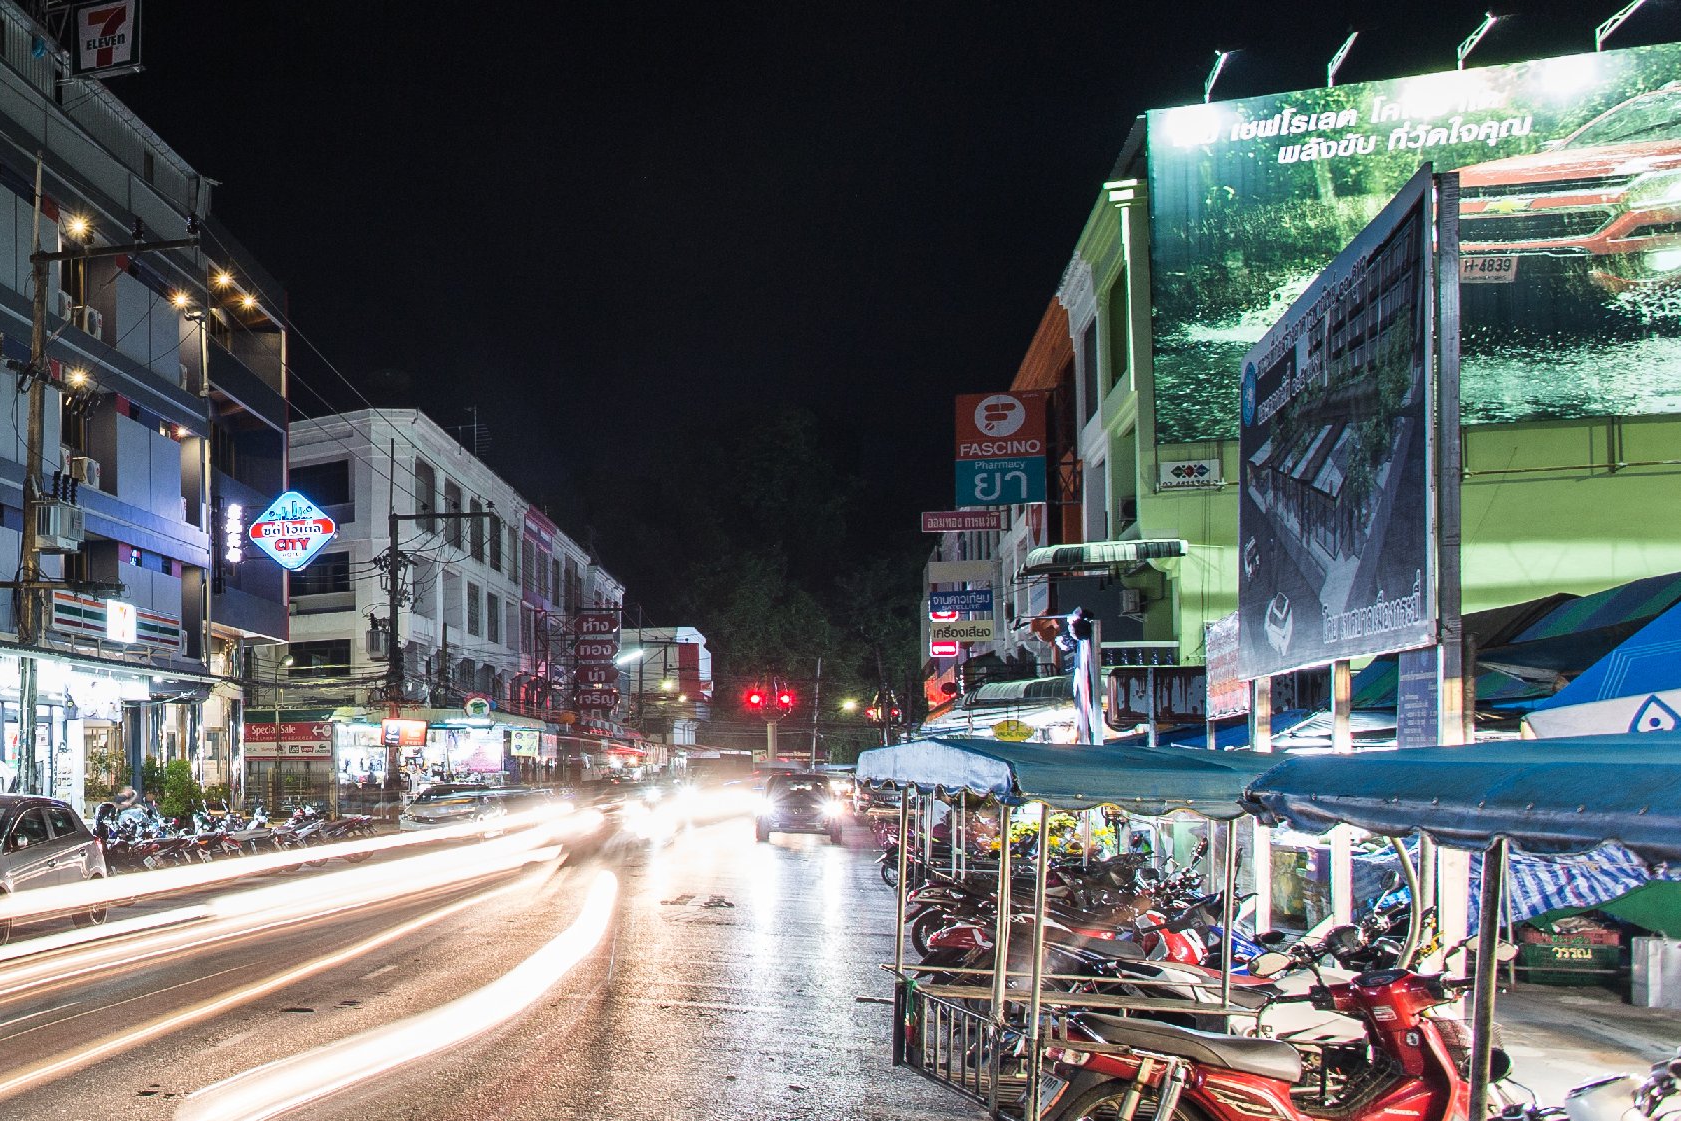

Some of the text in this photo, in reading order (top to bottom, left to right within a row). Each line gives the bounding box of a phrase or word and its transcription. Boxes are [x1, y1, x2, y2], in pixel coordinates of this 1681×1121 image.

[87, 4, 127, 68] 7
[1230, 108, 1357, 142] เชฟโรเลต
[1277, 134, 1376, 165] พลังขับ
[960, 439, 1041, 457] FASCINO
[974, 460, 1026, 470] Pharmacy
[974, 470, 1028, 501] ยา
[275, 537, 311, 551] CITY
[582, 618, 610, 632] ห้าง
[933, 624, 991, 638] เครื่องเสียง
[579, 644, 612, 656] ทอง
[579, 691, 615, 707] เจริญ
[251, 724, 296, 736] Specia Sale
